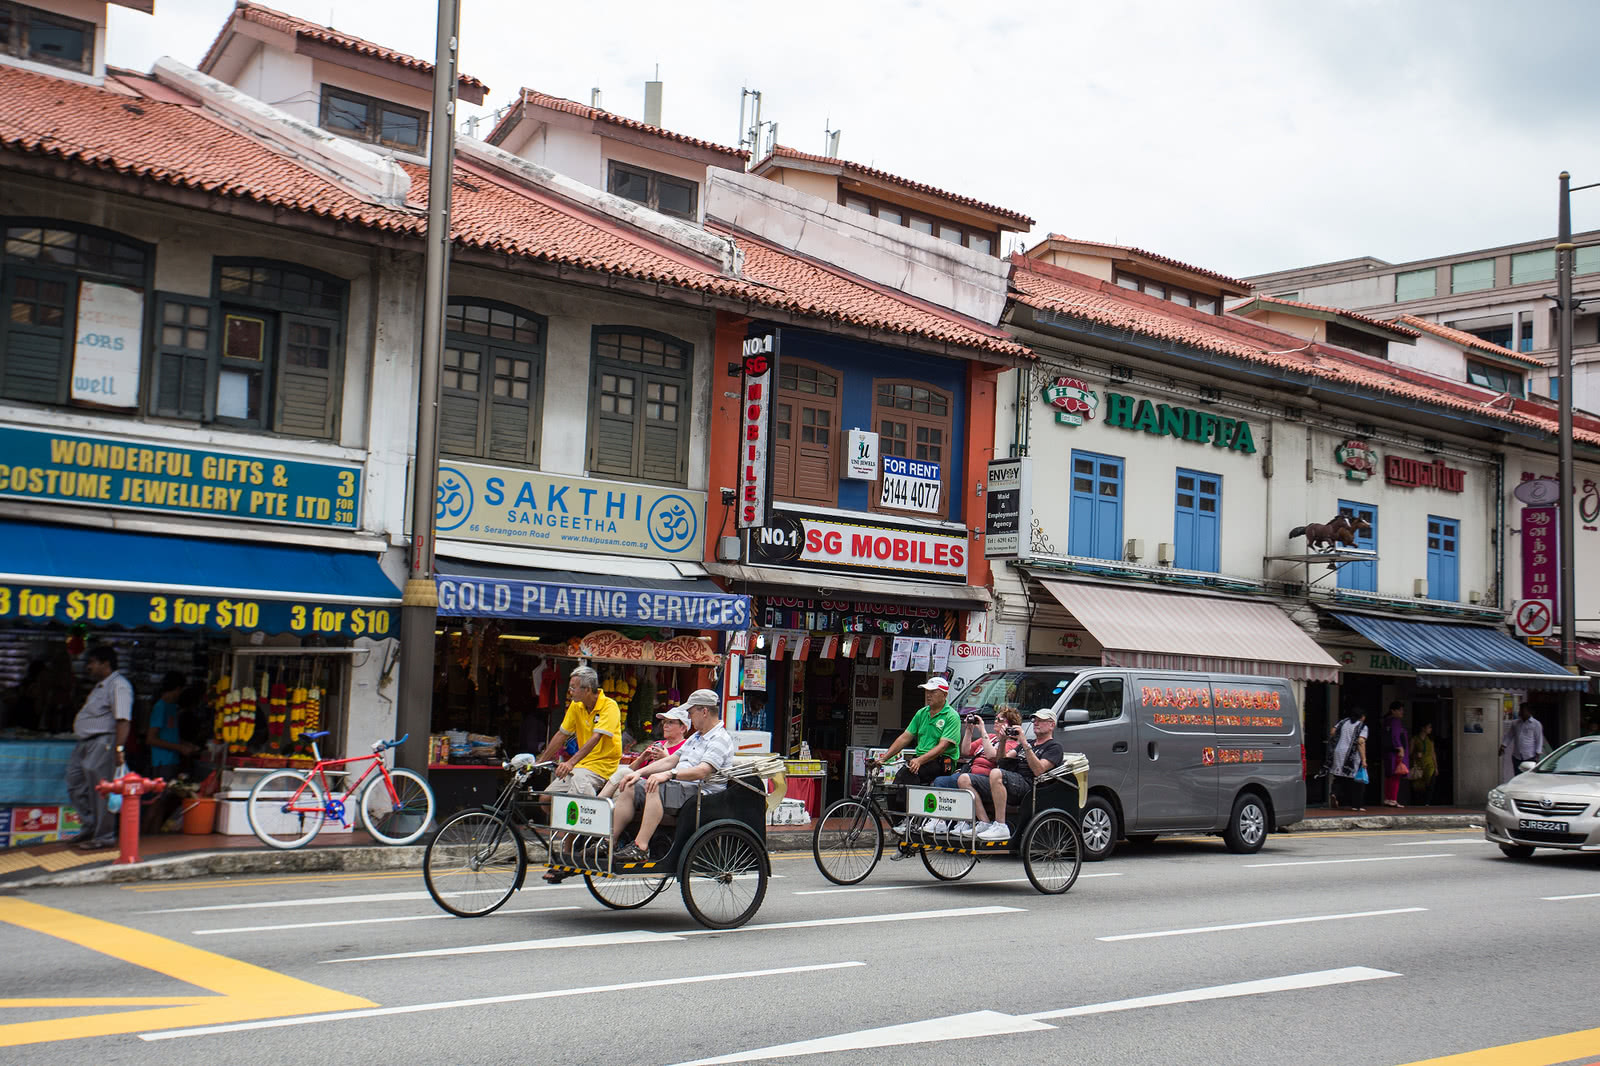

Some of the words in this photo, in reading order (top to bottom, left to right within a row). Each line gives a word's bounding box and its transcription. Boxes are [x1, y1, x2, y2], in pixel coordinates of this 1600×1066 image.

[742, 335, 772, 356] NO.1
[745, 356, 768, 375] SG
[1104, 392, 1256, 453] HANIFFA
[51, 439, 193, 478] WONDERFUL
[202, 456, 264, 485] GIFTS
[272, 464, 289, 488] &
[743, 384, 762, 522] MOBILES
[884, 458, 906, 474] FOR
[909, 462, 939, 478] RENT
[0, 464, 112, 499] COSTUME
[119, 477, 243, 512] JEWELLERY
[250, 491, 288, 517] PTE
[295, 496, 331, 520] LTD
[337, 471, 355, 497] 3
[883, 477, 907, 506] 9144
[911, 481, 939, 508] 4077
[336, 498, 354, 510] FOR
[484, 477, 642, 521] SAKTHI
[334, 511, 353, 523] $10
[507, 510, 617, 533] SANGEETHA
[988, 511, 1018, 519] Employment
[993, 521, 1012, 529] Agency
[469, 524, 480, 532] 66
[483, 525, 528, 537] Serangoon
[529, 530, 550, 539] Road
[561, 534, 648, 550] www.thaipusam.com.sg
[761, 527, 798, 547] NO.1
[806, 529, 842, 554] SG
[852, 533, 964, 567] MOBILES
[18, 589, 60, 616] for
[66, 590, 115, 620] $10
[149, 597, 167, 623] 3
[173, 598, 210, 624] for
[216, 599, 259, 628] $10
[438, 580, 512, 612] GOLD
[522, 587, 627, 618] PLATING
[637, 593, 746, 625] SERVICES
[290, 605, 306, 630] 3
[312, 607, 345, 632] for
[350, 608, 390, 635] $10
[958, 646, 970, 655] SG
[970, 646, 1001, 657] MOBILES
[1519, 820, 1567, 831] SJR6224T
